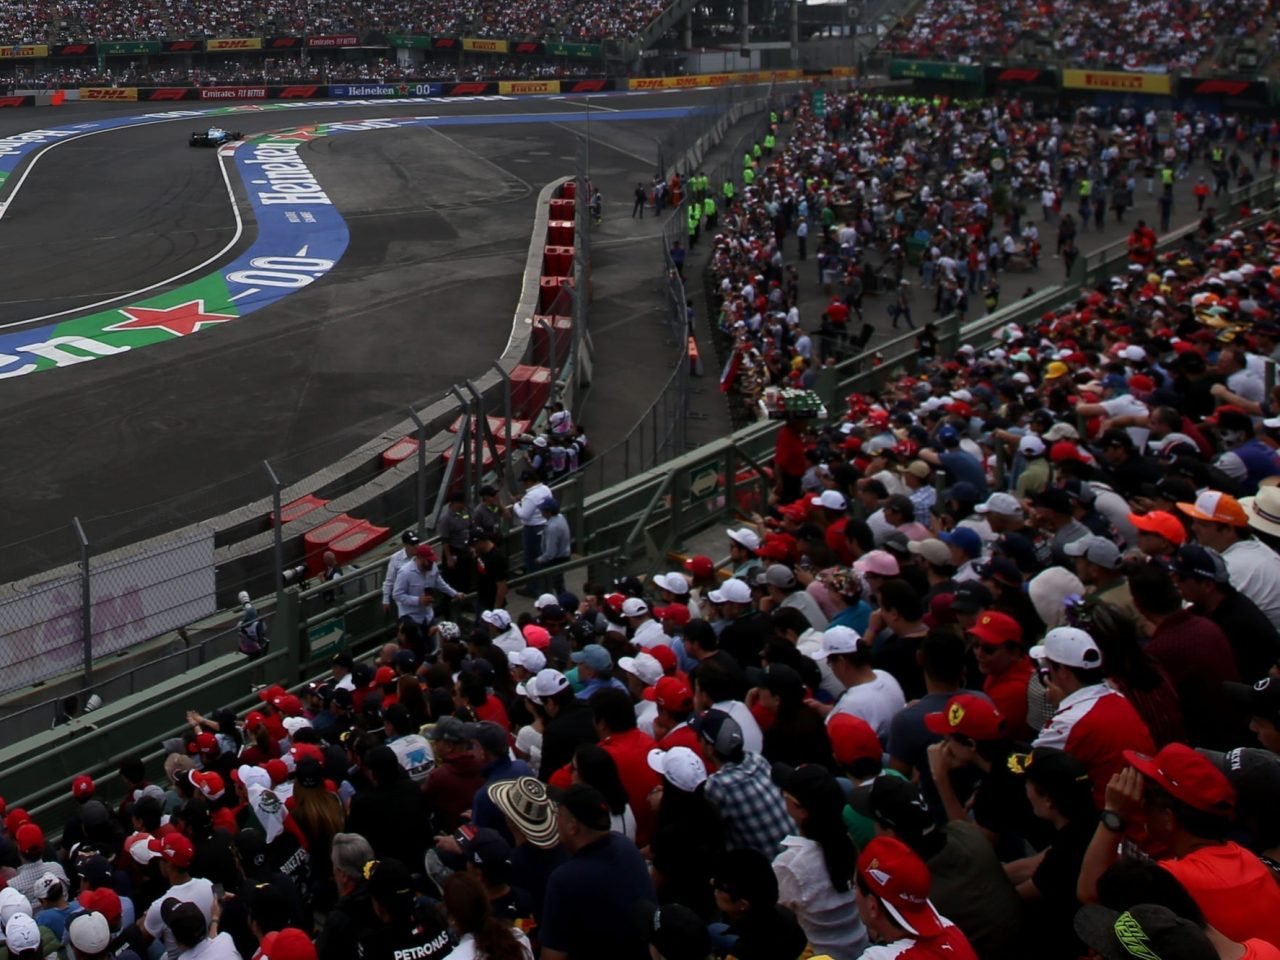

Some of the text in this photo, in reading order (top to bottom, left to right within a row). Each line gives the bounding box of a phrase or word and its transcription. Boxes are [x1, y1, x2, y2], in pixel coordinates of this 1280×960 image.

[636, 80, 664, 88] DHL
[676, 78, 699, 86] DHL
[1085, 74, 1143, 88] PIRELLI
[88, 90, 128, 98] DHL
[349, 86, 394, 96] Heineken
[244, 142, 333, 205] Heineken
[393, 930, 449, 960] PETRONAS
